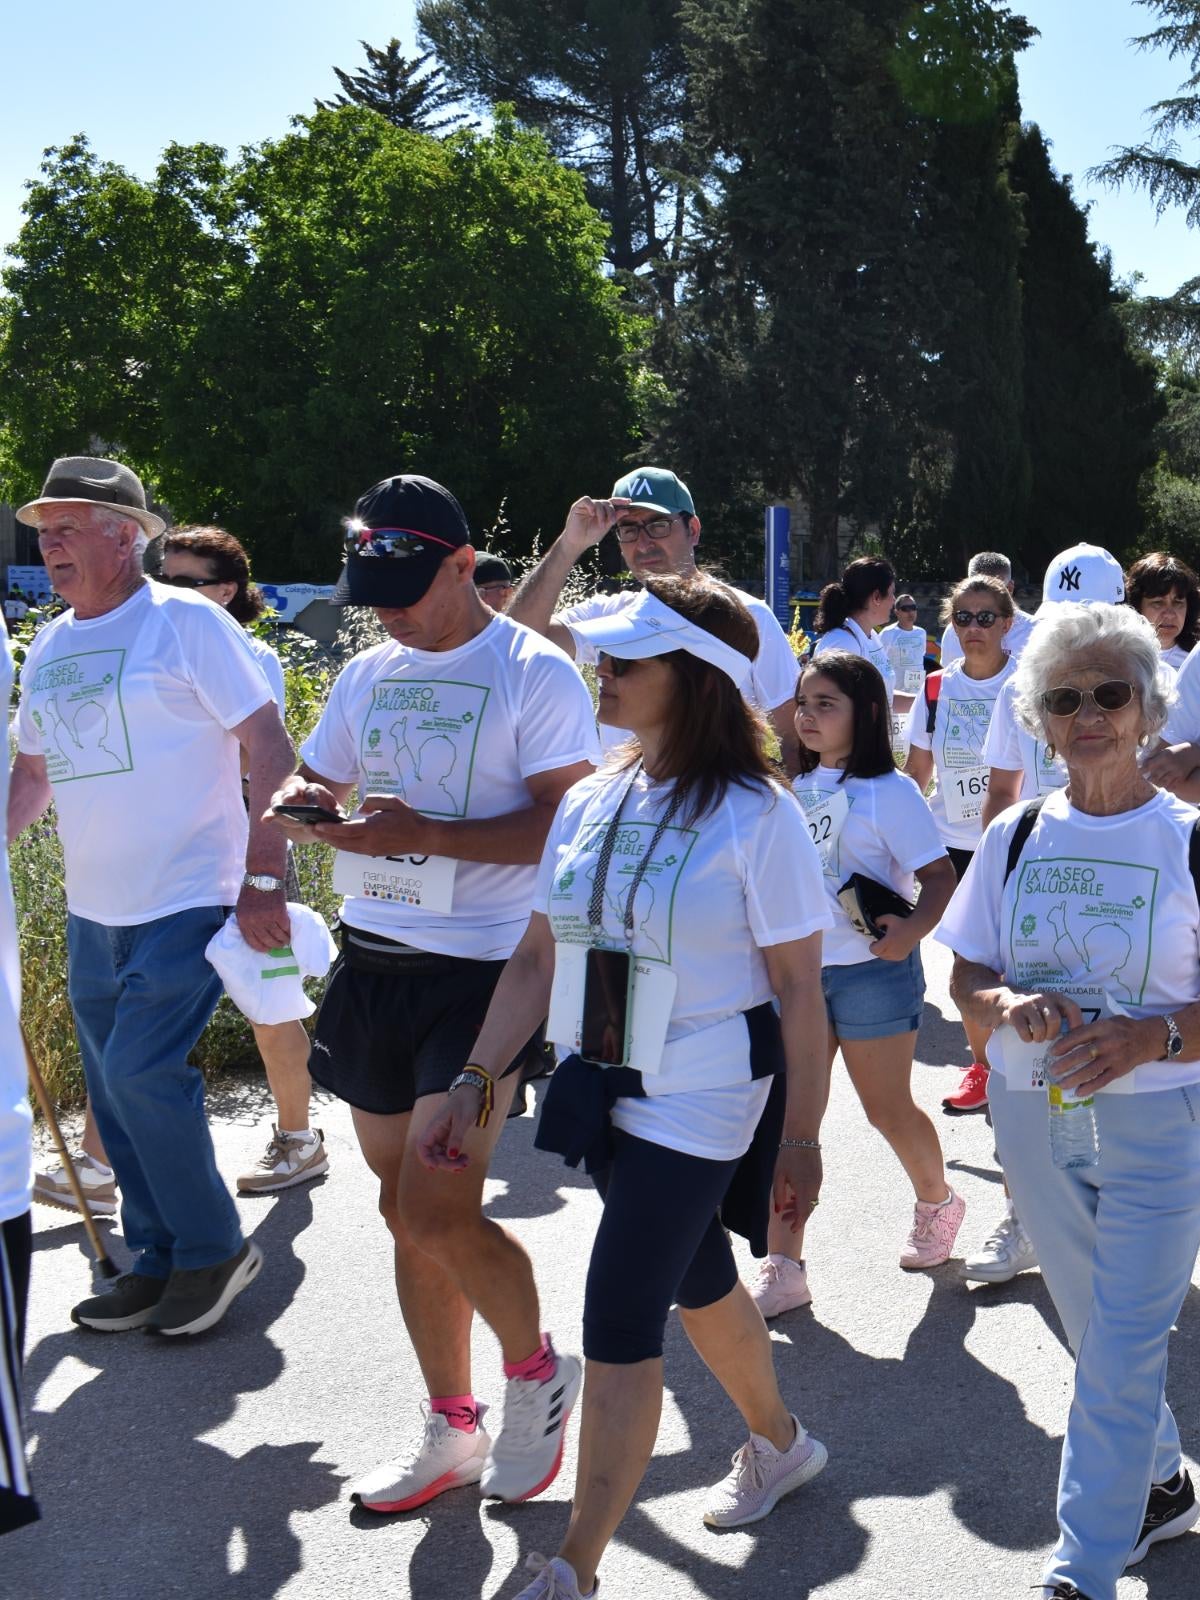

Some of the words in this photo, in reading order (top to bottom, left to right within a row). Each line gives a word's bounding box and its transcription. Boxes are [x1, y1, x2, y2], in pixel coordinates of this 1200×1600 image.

[378, 687, 391, 700] IX
[393, 687, 435, 701] PASEO
[375, 699, 442, 713] SALUDABLE
[363, 871, 387, 881] nani
[389, 874, 423, 889] grupo
[1026, 867, 1041, 882] IX
[1044, 866, 1096, 883] PASEO
[363, 881, 422, 898] EMPRESARIAL
[1024, 880, 1104, 897] SALUDABLE
[1084, 903, 1099, 913] San
[633, 965, 652, 976] ABLE
[1059, 986, 1103, 996] SALUDABLE
